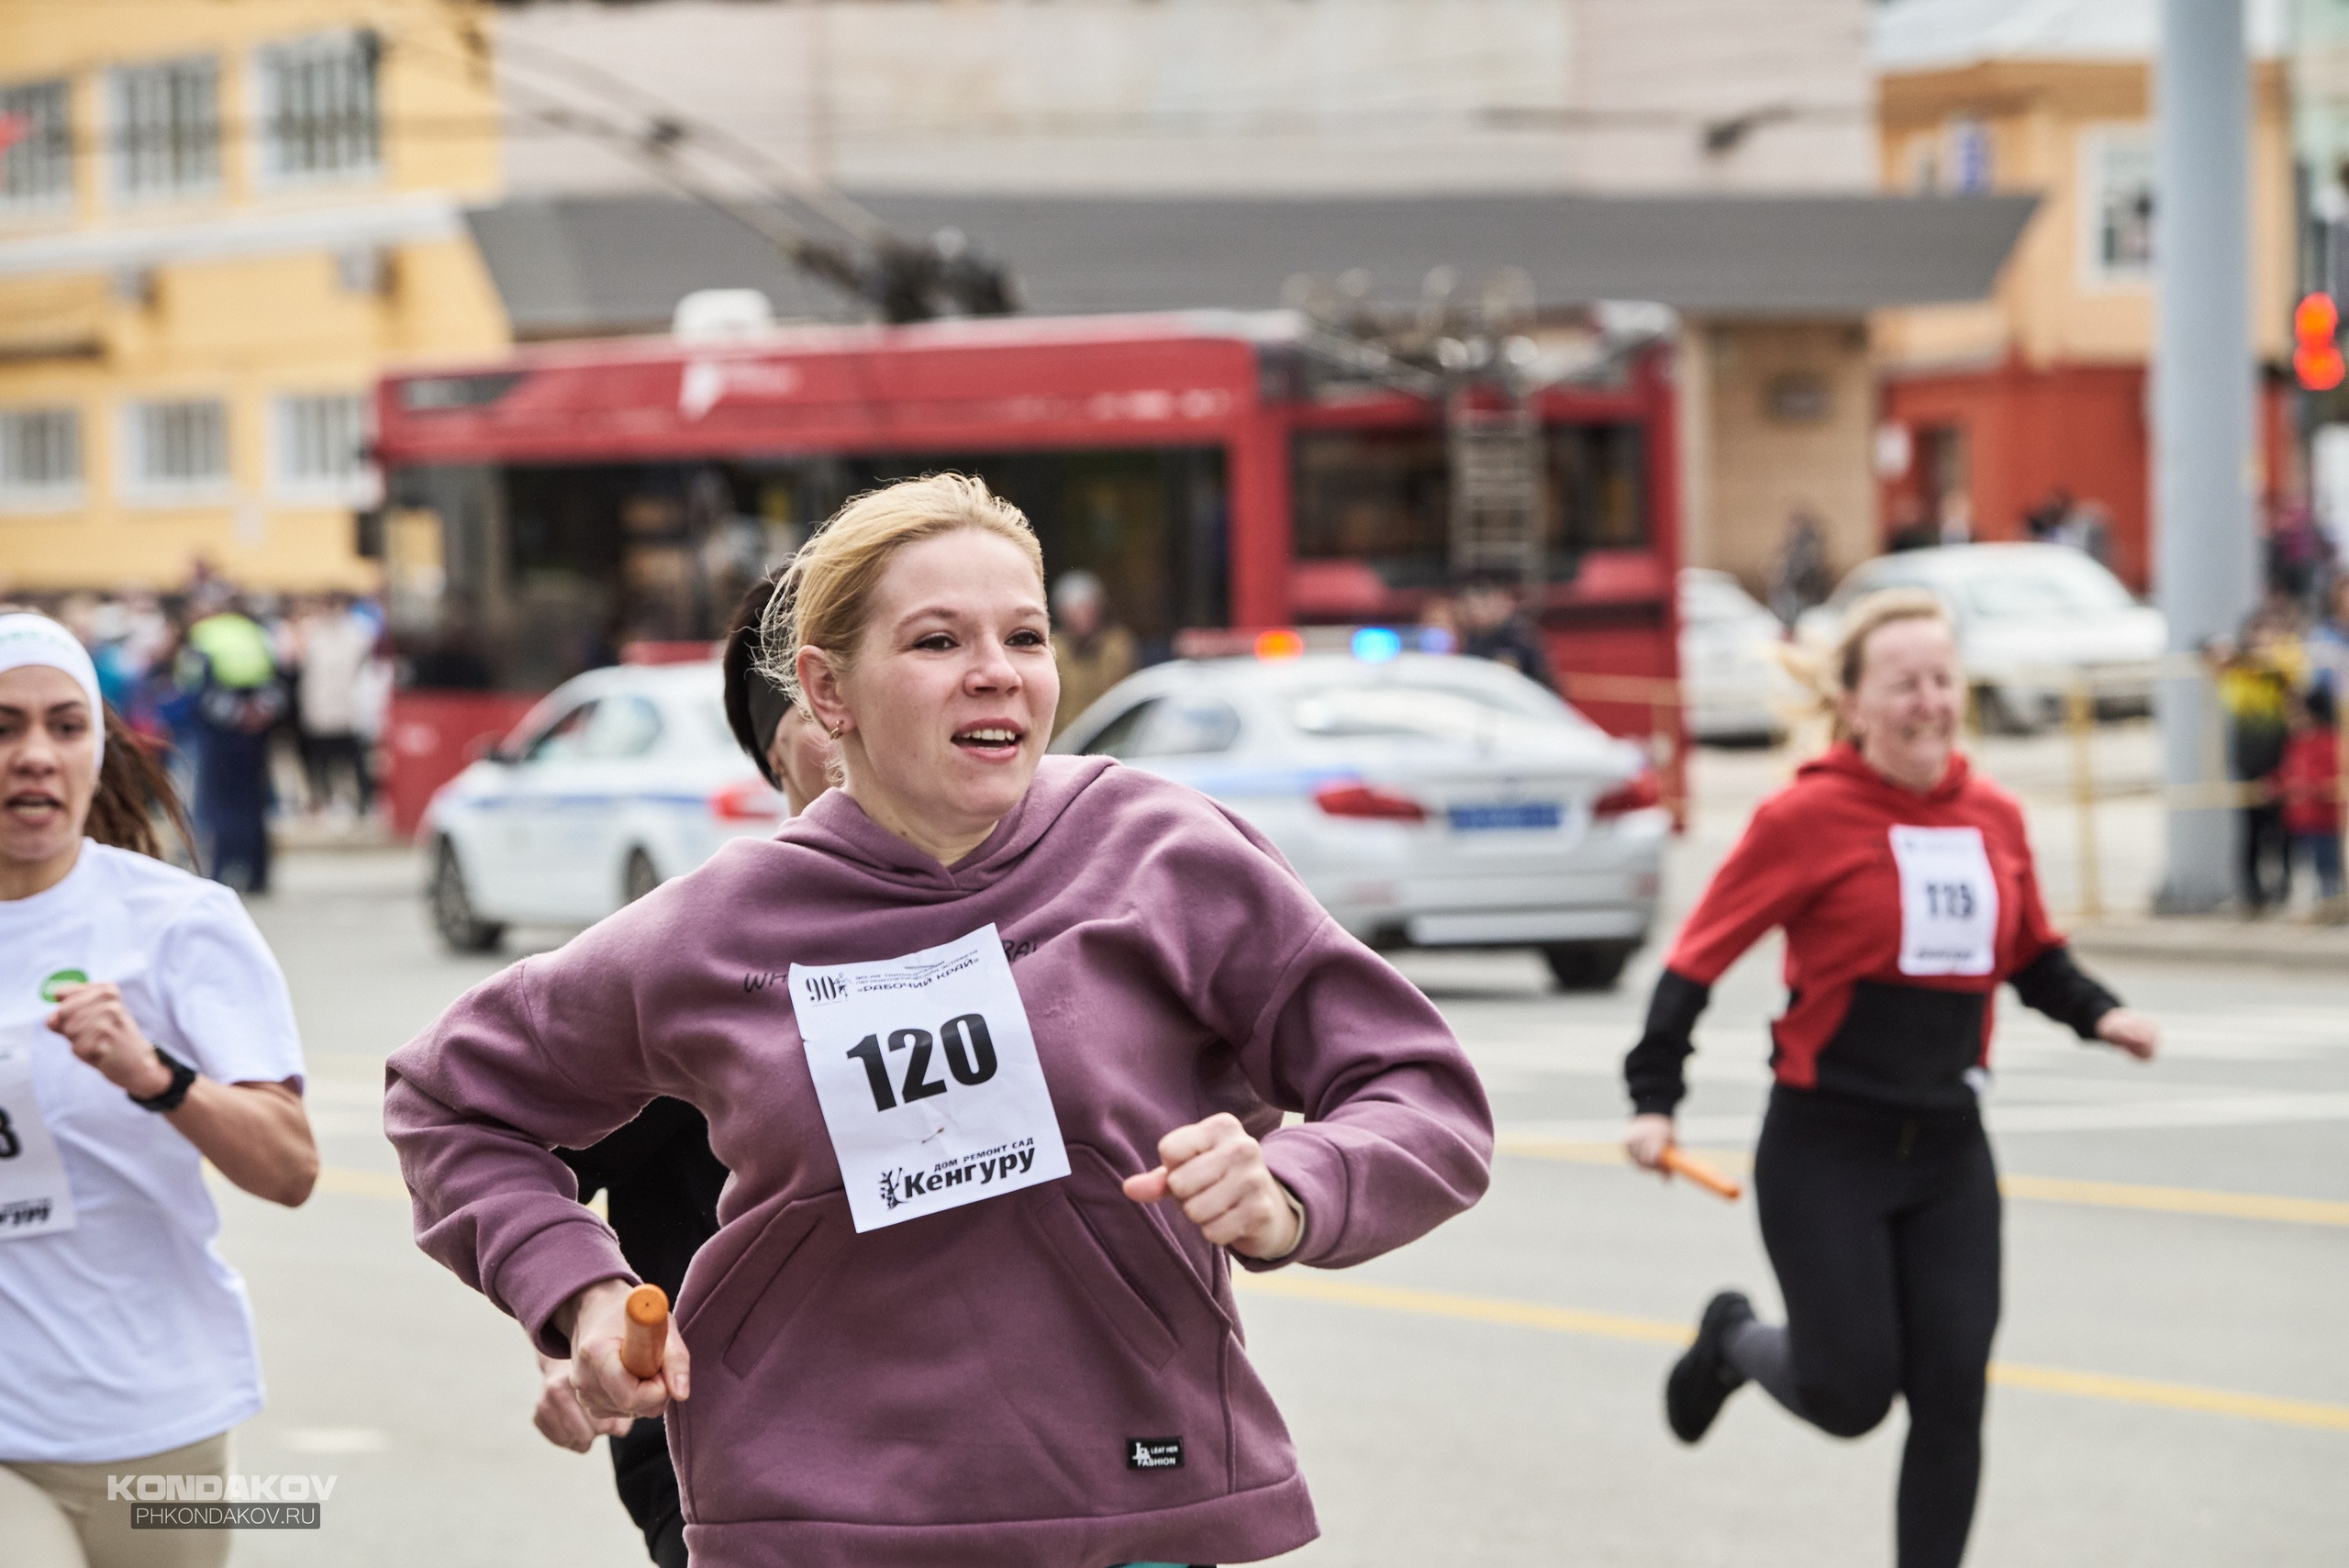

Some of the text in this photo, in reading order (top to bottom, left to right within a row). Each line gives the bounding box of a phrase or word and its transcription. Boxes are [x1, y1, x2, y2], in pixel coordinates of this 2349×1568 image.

[806, 975, 836, 1003] 90
[846, 1013, 998, 1112] 120
[904, 1148, 1036, 1198] Кенгуру
[934, 1137, 1034, 1173] ДОМ РЕМОНТ САД
[1137, 1457, 1176, 1467] FASHION
